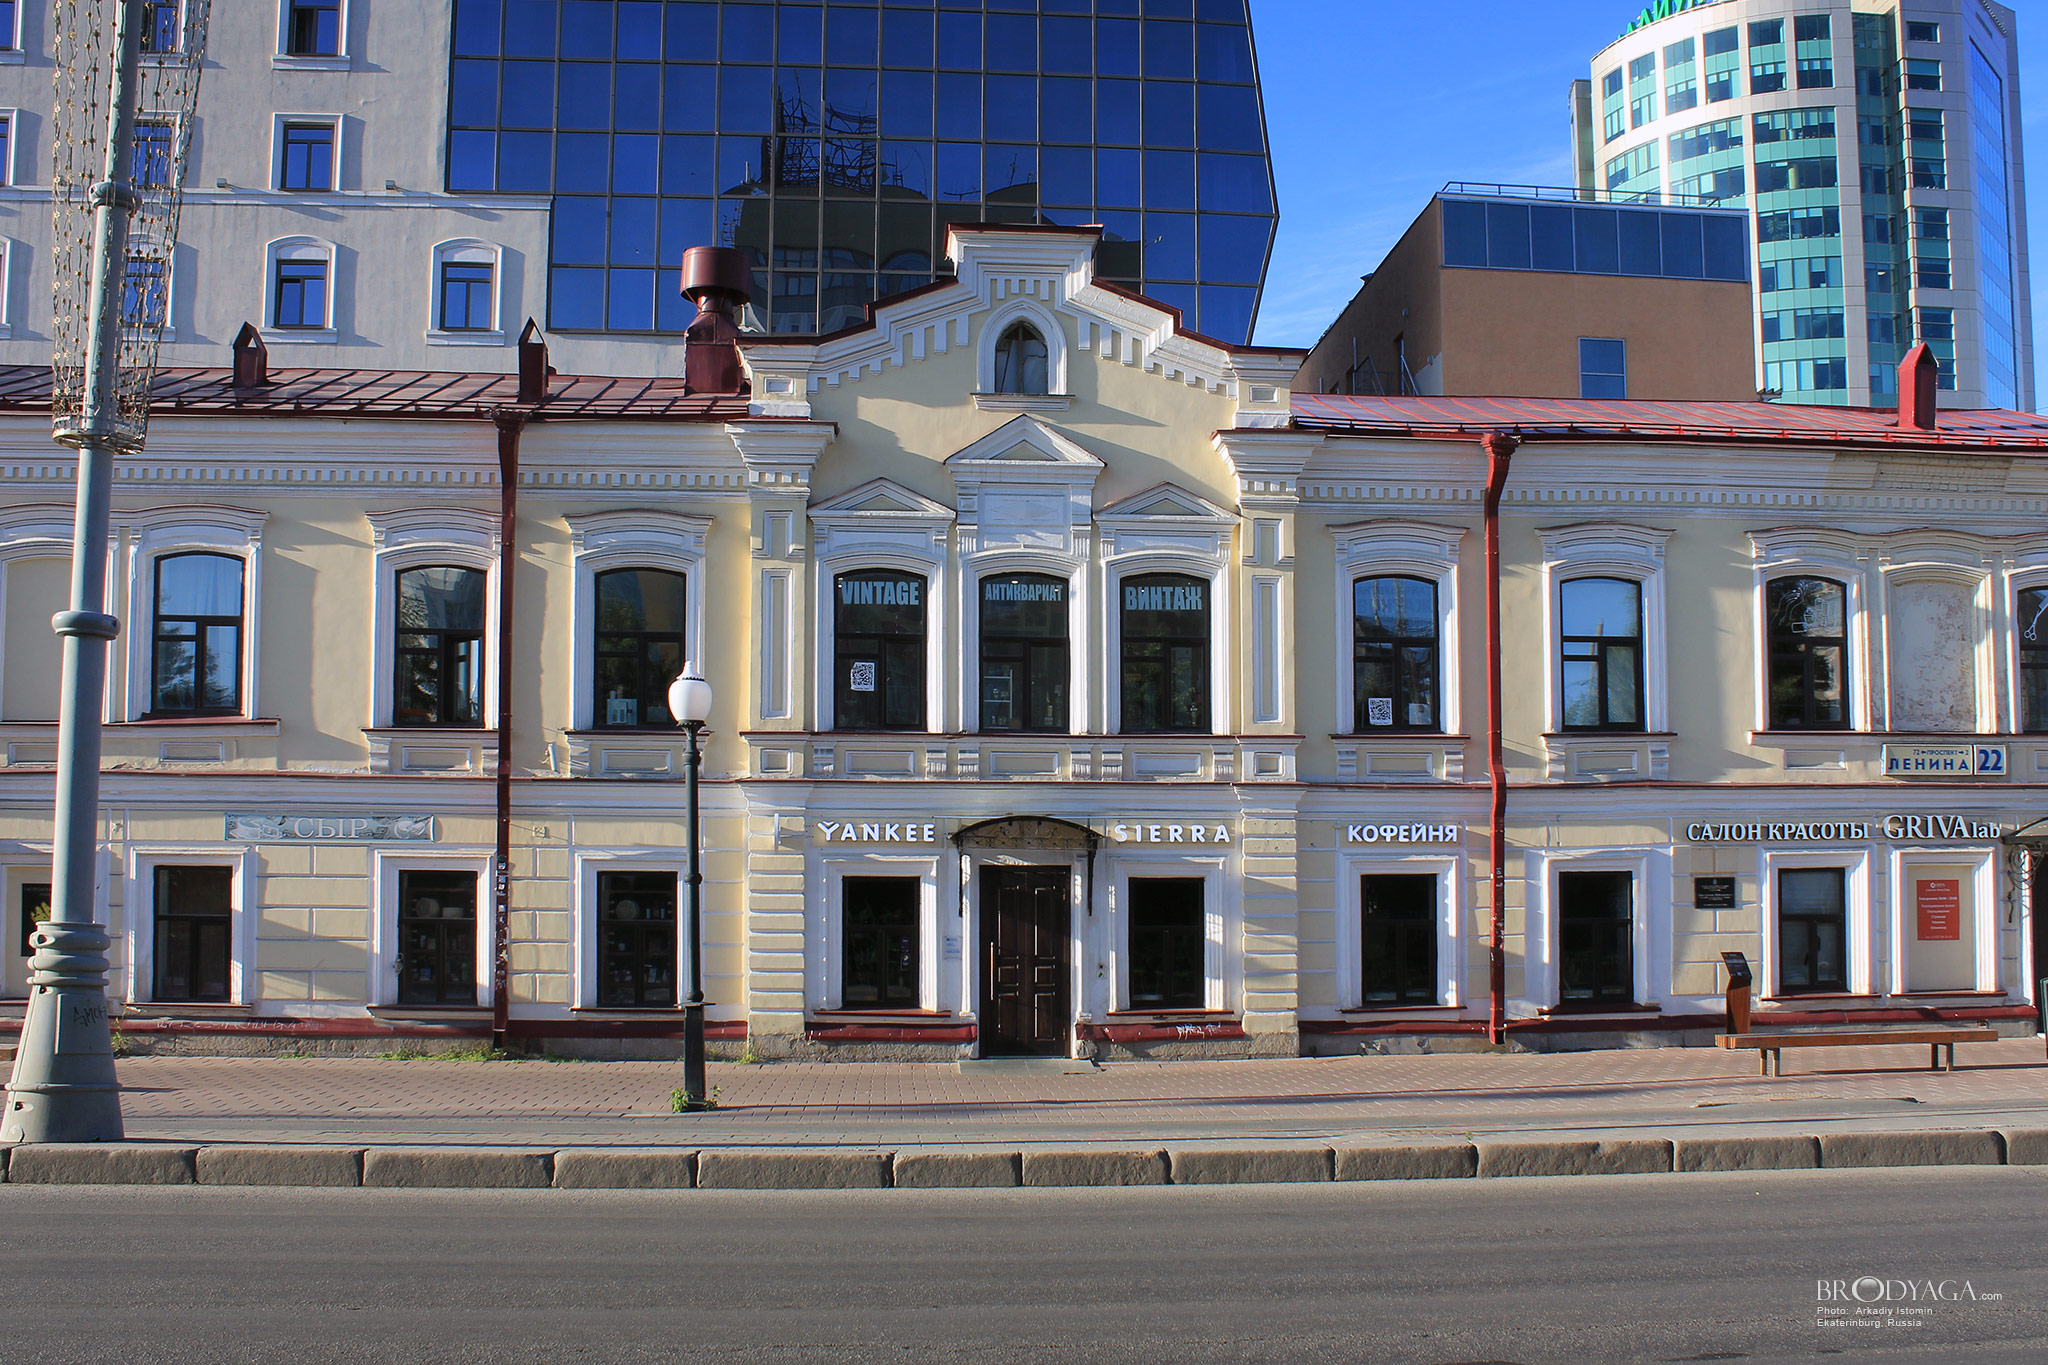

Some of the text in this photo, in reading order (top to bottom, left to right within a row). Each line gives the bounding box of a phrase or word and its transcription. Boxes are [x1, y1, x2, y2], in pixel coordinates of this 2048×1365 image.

[841, 581, 919, 605] VINTAGE
[985, 583, 1063, 601] АНТИКВАРИАТ
[1125, 586, 1202, 611] ВИНТАЖ
[1888, 758, 1969, 770] ЛЕНИНА
[1978, 749, 2003, 771] 22
[293, 818, 369, 838] СЫР
[817, 821, 1231, 843] YANKEE SIERRA
[1347, 823, 1458, 842] КОФЕЙНЯ
[1686, 823, 1761, 841] САЛОН
[1766, 822, 1869, 840] КРАСОТЫ
